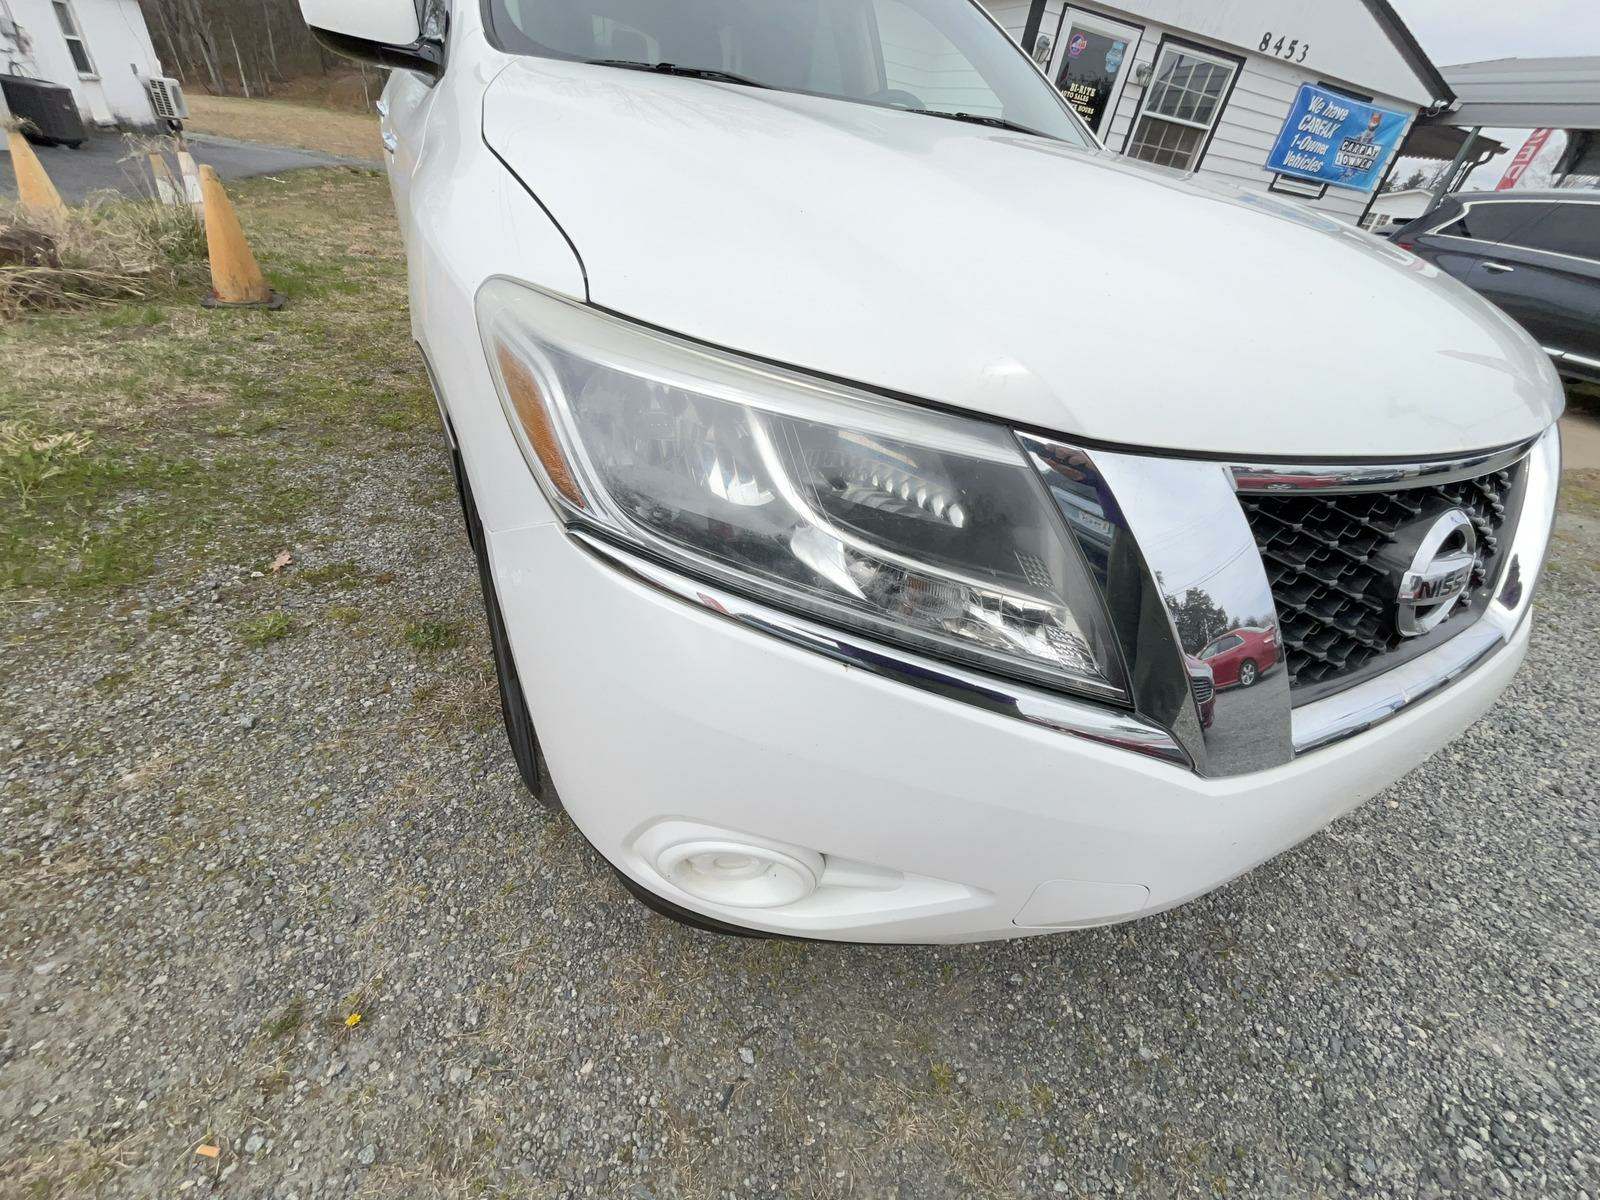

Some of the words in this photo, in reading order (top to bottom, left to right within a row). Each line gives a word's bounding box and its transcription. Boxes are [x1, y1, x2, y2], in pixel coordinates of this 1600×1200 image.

[1258, 32, 1310, 63] 8453
[1070, 83, 1096, 97] BI-RITE
[1073, 94, 1089, 102] SALES
[1078, 105, 1094, 114] HOURS
[1308, 95, 1325, 114] We
[1322, 100, 1350, 121] have
[1297, 114, 1341, 139] CARFAX
[1290, 133, 1329, 156] 1-Owner
[1341, 140, 1381, 158] CARFAX
[1282, 150, 1324, 173] Vehicles
[1342, 155, 1373, 170] OWNER
